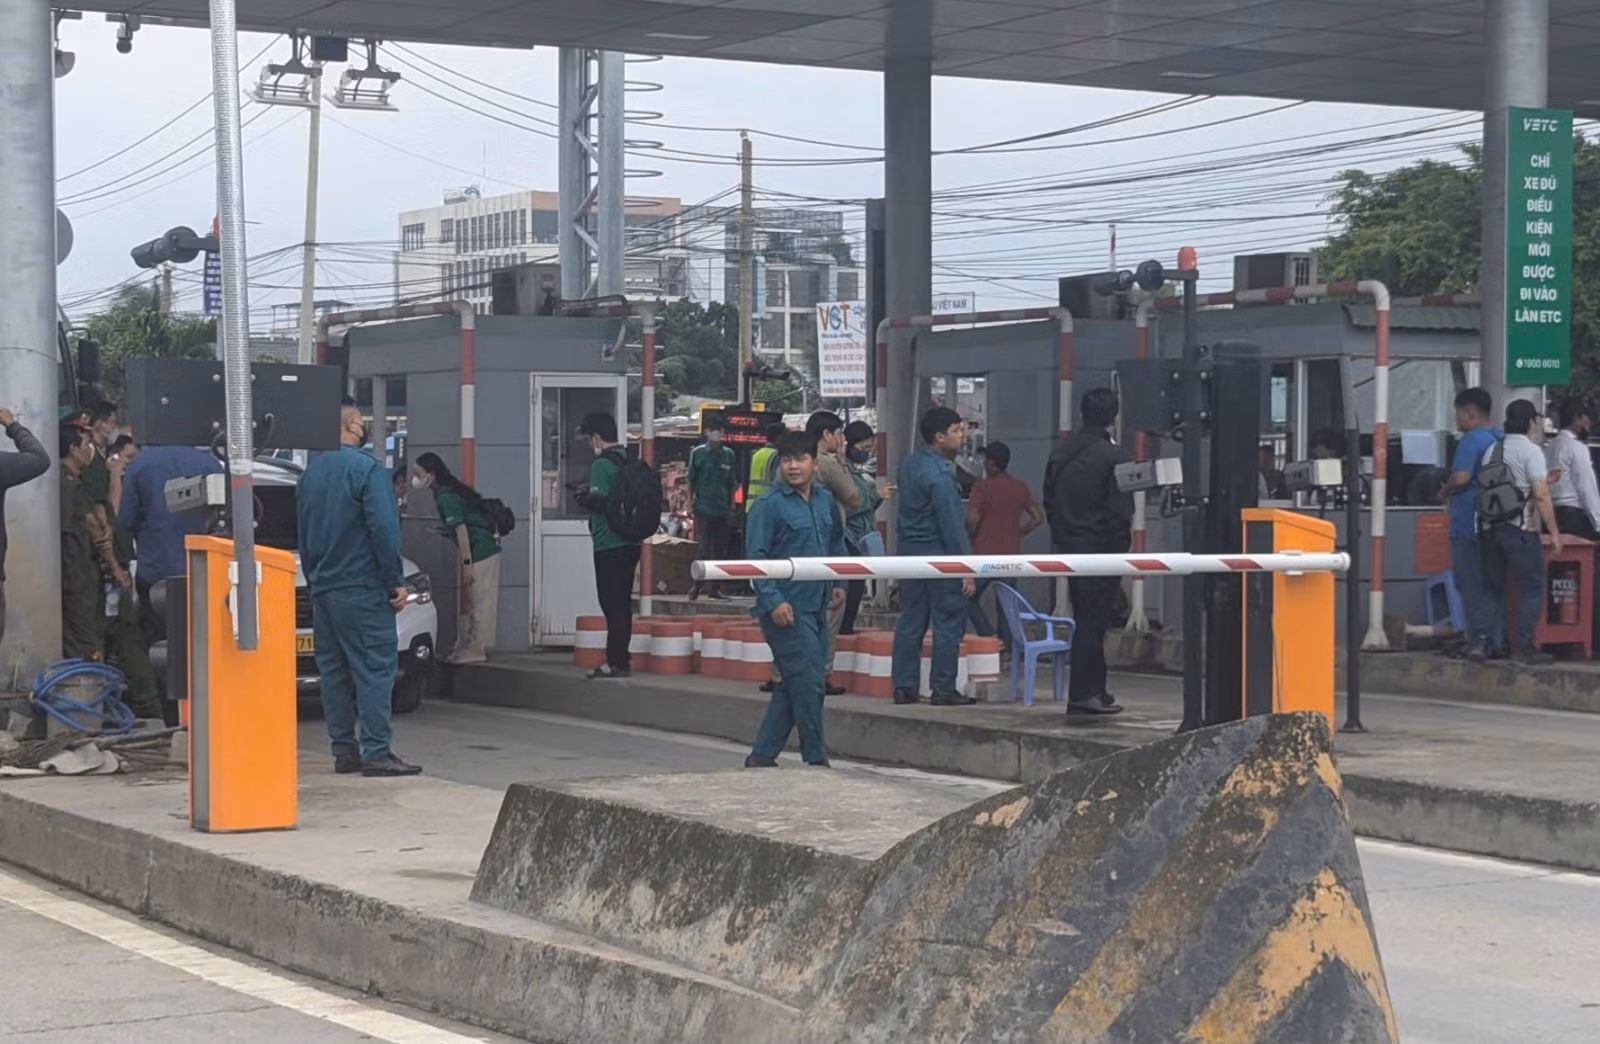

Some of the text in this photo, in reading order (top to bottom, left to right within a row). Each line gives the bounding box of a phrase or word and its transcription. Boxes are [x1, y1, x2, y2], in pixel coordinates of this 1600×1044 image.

[1523, 118, 1558, 132] VETC
[1524, 174, 1557, 190] XE ĐỦ
[1526, 218, 1553, 238] KIỆN
[1522, 265, 1556, 282] ĐƯỢC
[1520, 284, 1557, 301] ĐI VÀO
[1515, 306, 1562, 323] LÀN ETC
[1524, 359, 1541, 368] 1900
